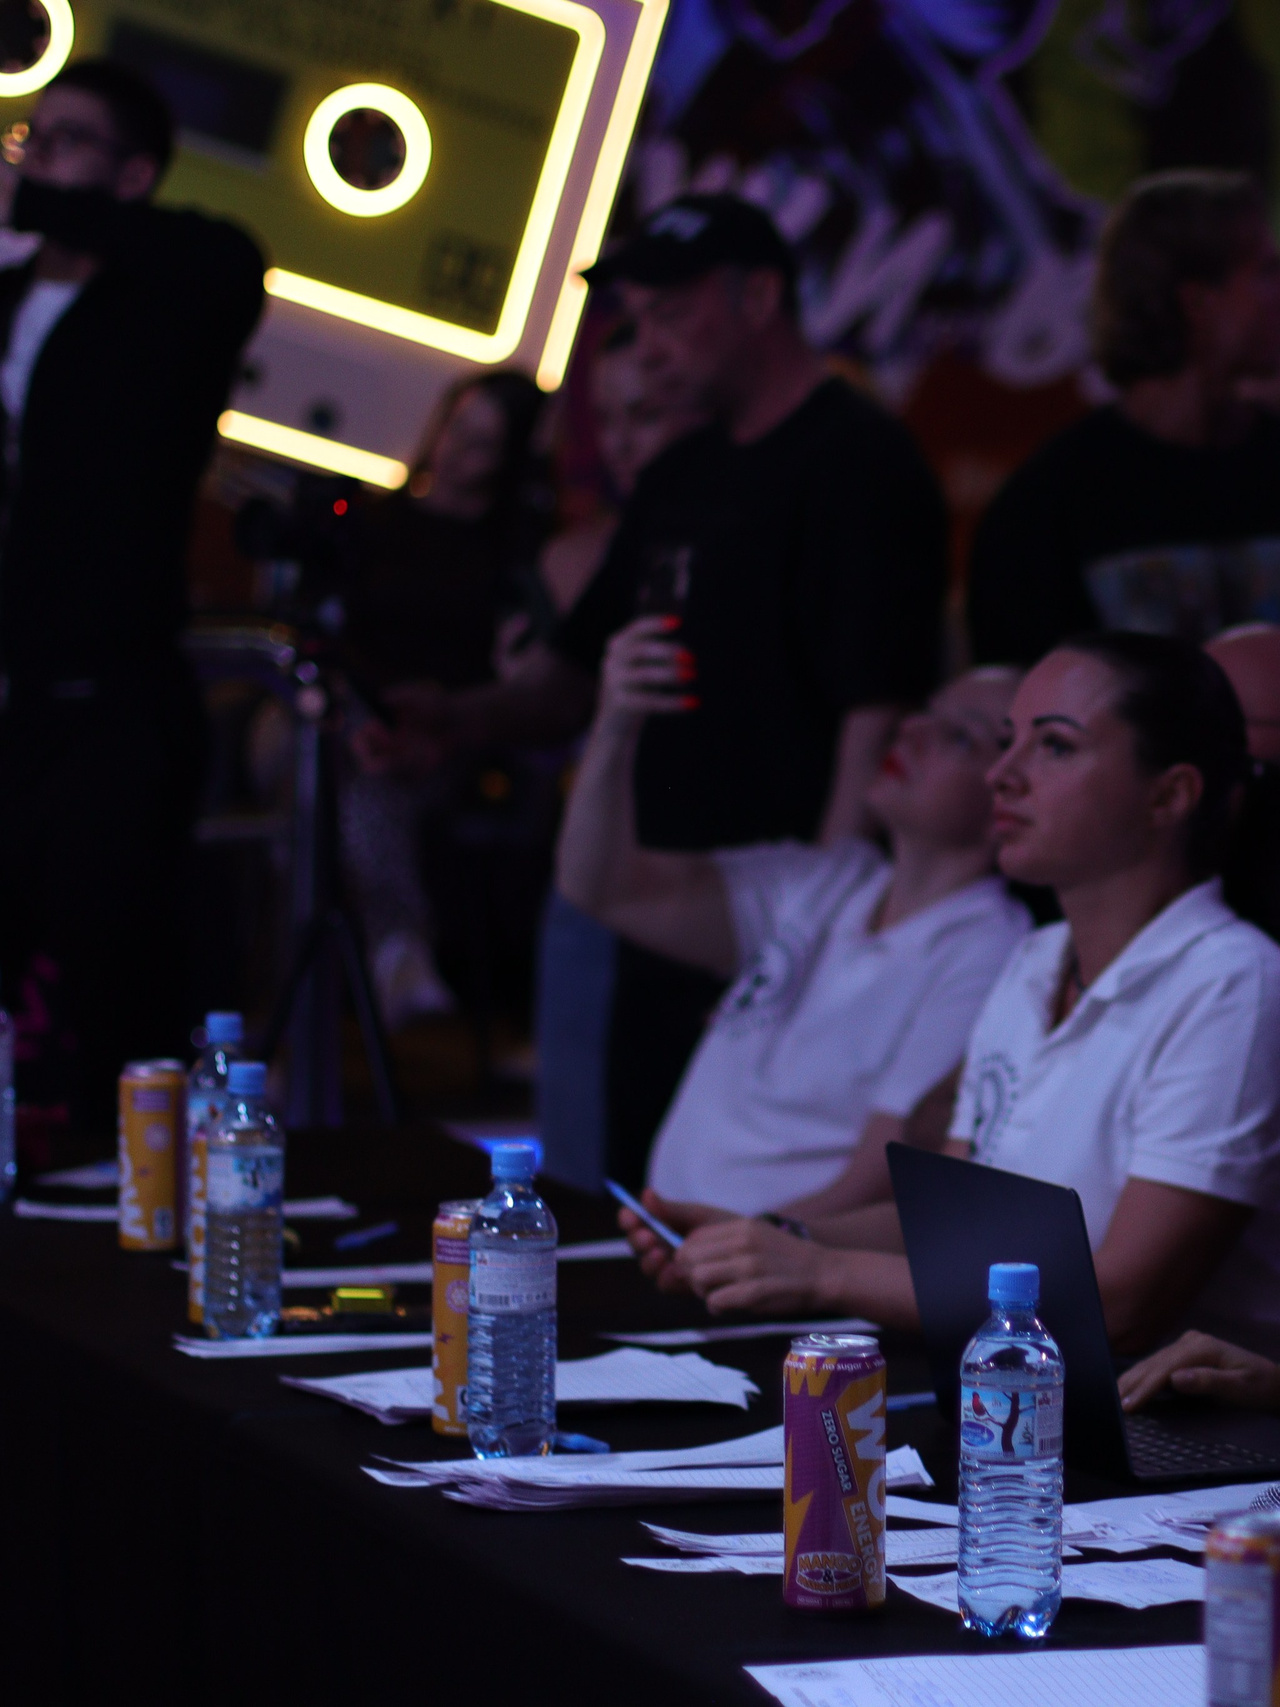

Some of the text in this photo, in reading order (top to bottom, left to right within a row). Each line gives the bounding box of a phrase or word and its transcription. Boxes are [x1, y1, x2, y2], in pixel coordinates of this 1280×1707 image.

[822, 1362, 835, 1371] no
[836, 1361, 863, 1373] sugar
[821, 1408, 853, 1495] ZERO SUGAR
[849, 1500, 881, 1585] ENERGY
[798, 1552, 862, 1574] MANGO
[823, 1568, 834, 1583] &
